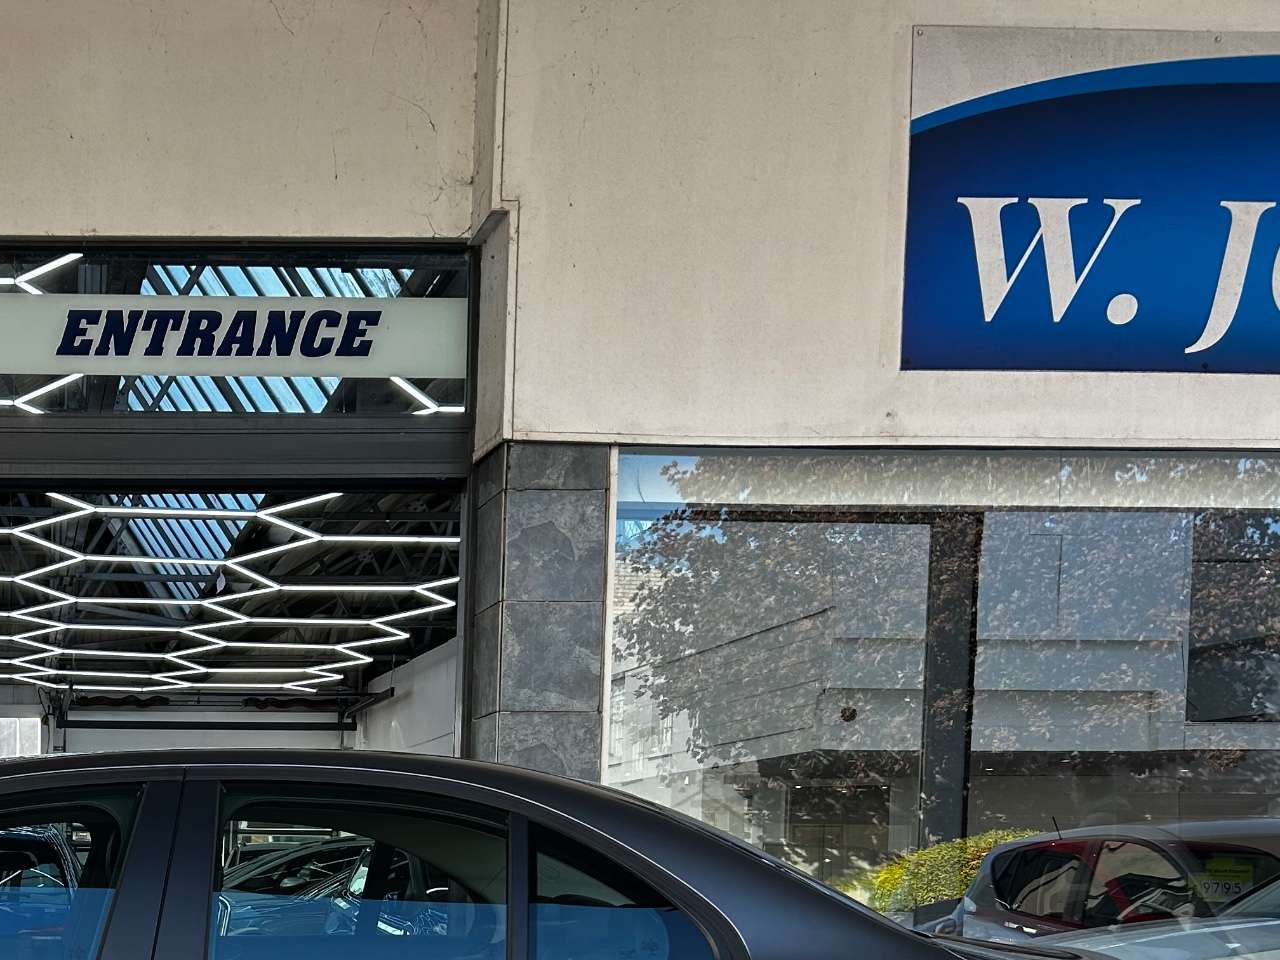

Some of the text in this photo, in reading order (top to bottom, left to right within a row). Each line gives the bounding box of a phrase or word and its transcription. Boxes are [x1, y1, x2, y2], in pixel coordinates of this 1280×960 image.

[956, 196, 1280, 354] W. J
[55, 308, 383, 358] ENTRANCE
